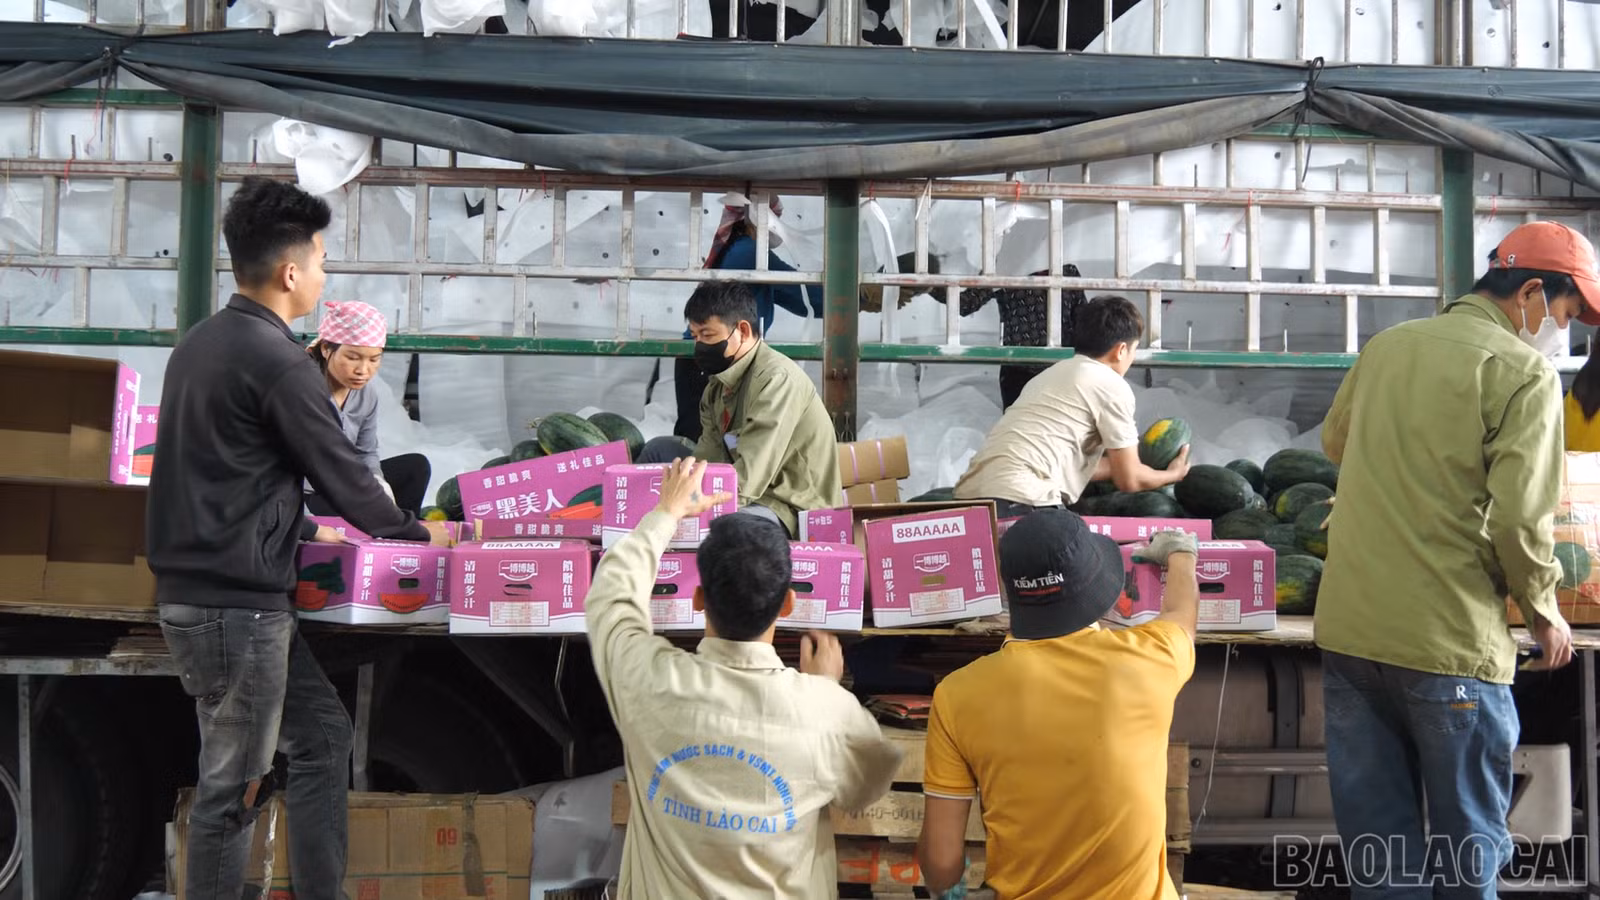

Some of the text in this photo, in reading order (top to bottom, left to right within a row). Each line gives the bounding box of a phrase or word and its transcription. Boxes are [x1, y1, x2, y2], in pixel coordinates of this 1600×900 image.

[557, 454, 605, 473] 送礼佳品
[496, 488, 564, 519] 黑美人
[896, 522, 961, 539] 88AAAAA
[1456, 684, 1469, 699] R
[746, 815, 778, 834] CAI
